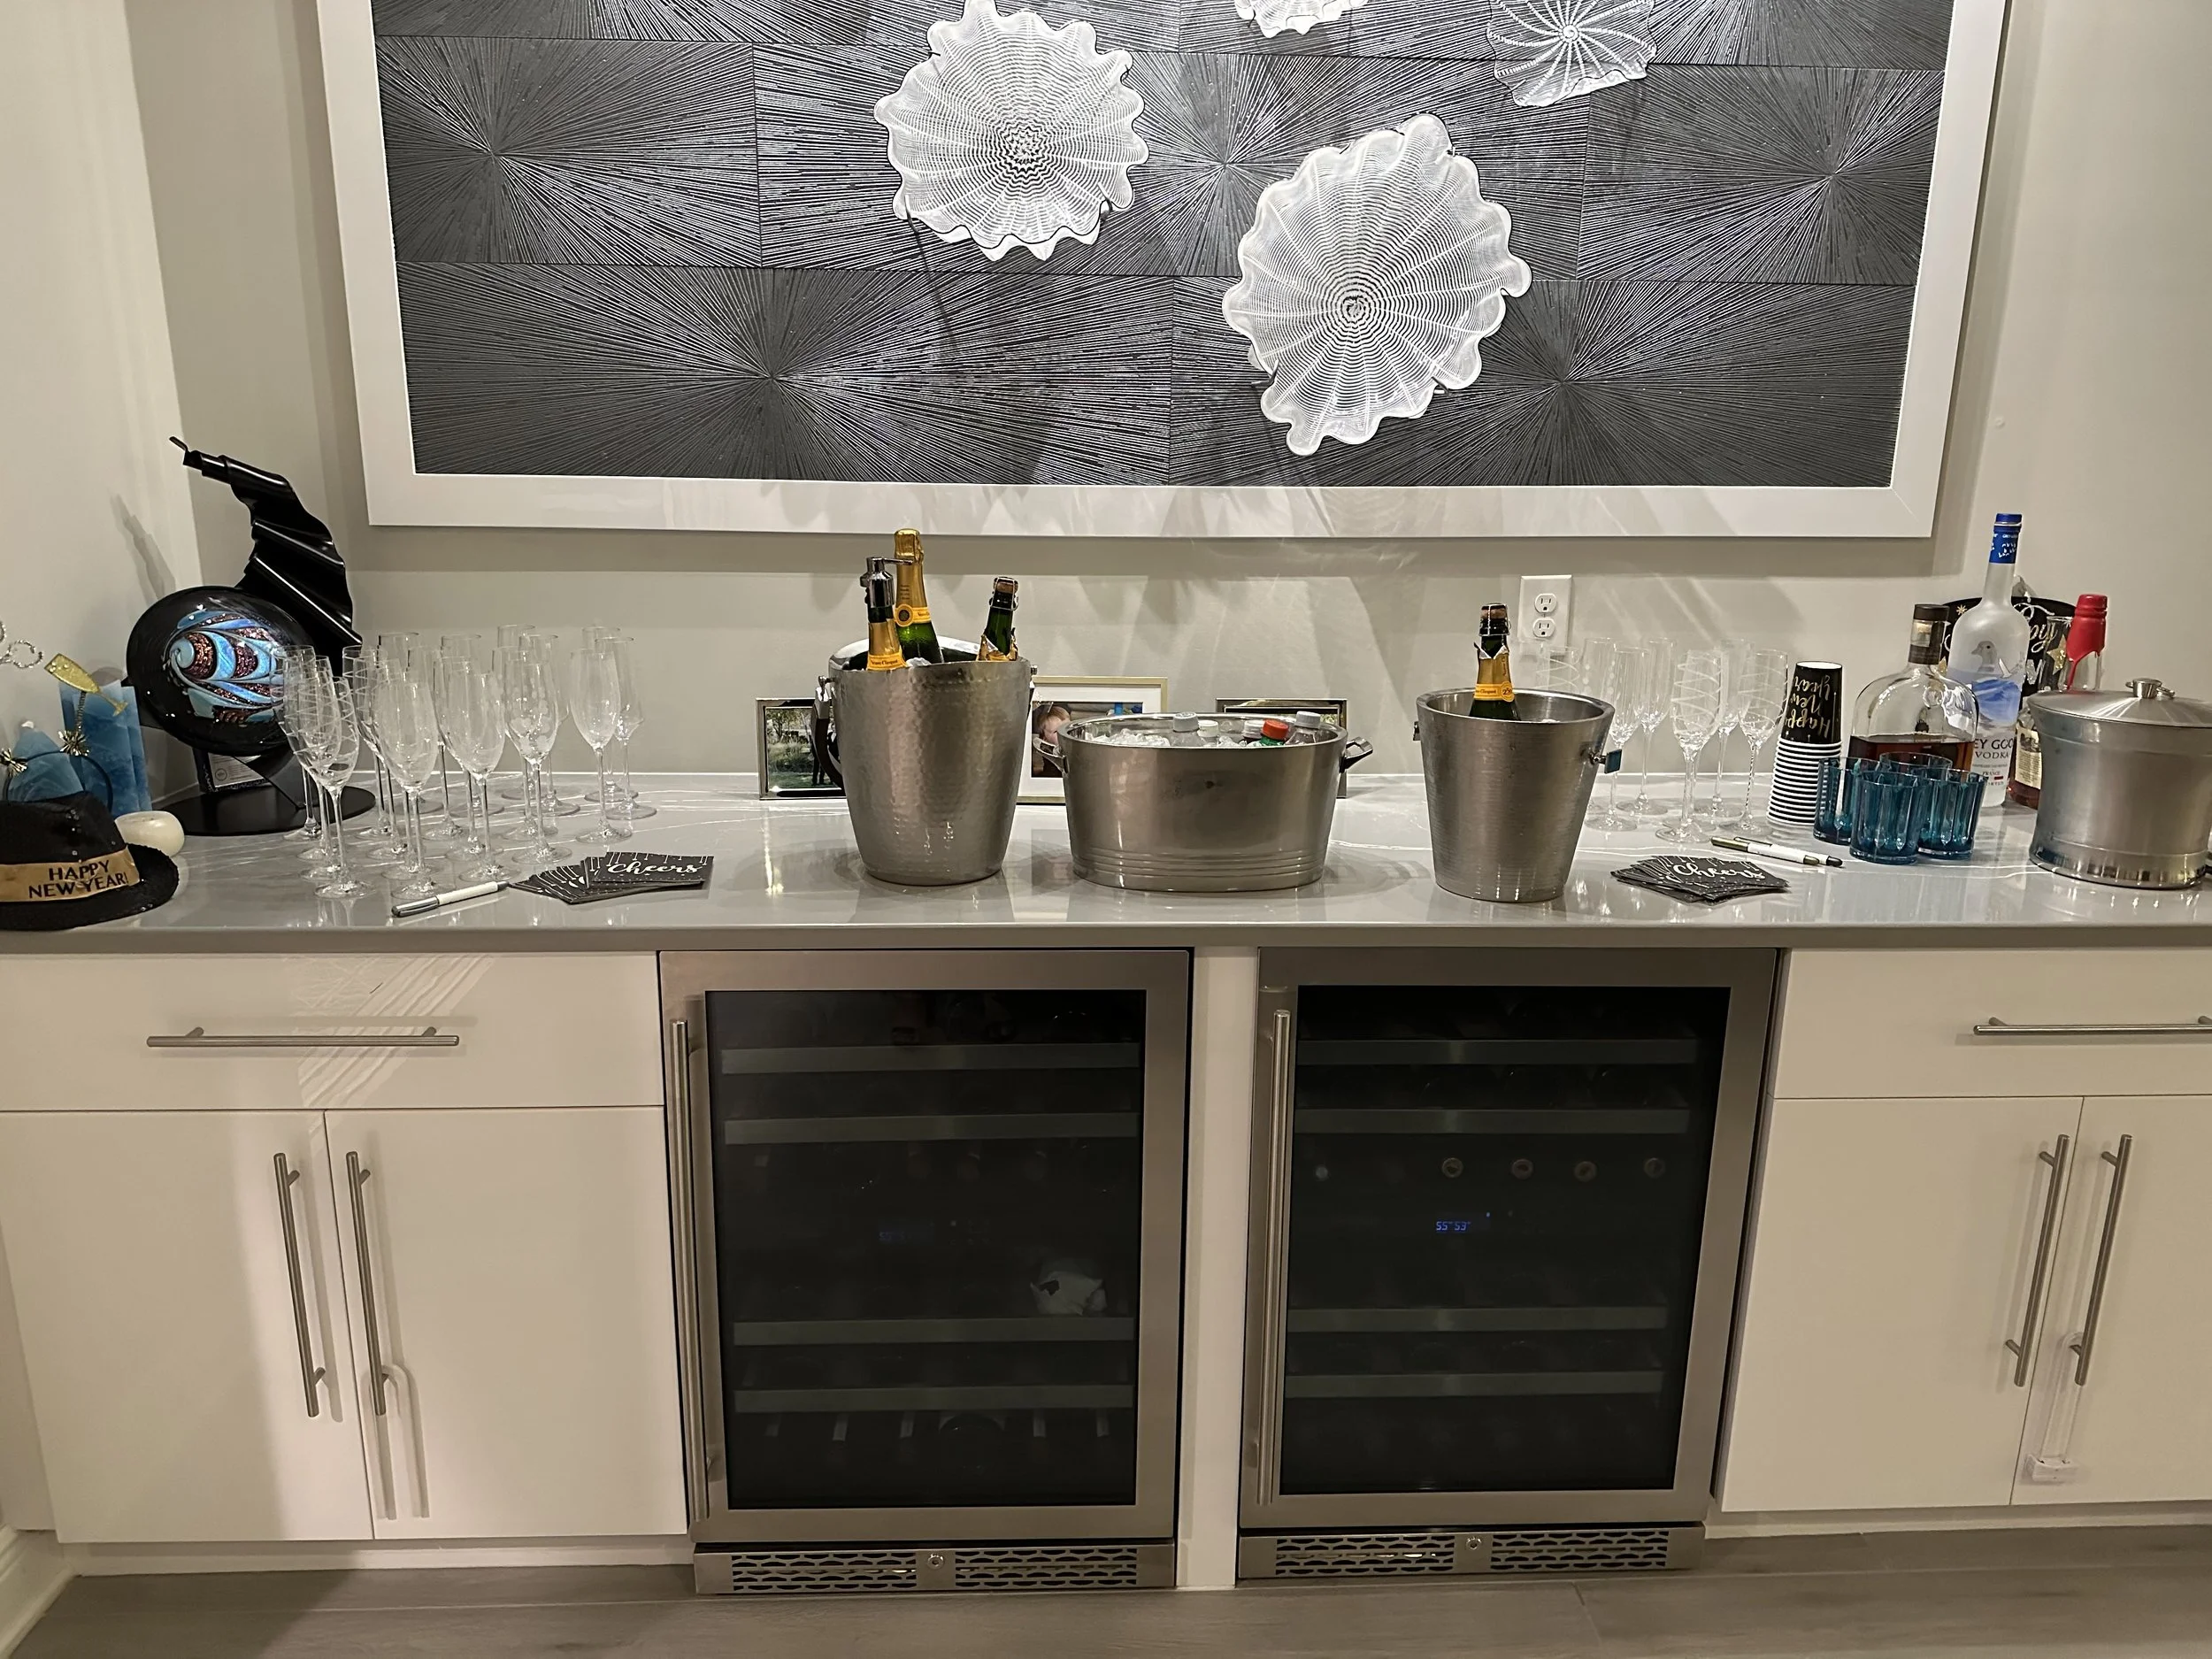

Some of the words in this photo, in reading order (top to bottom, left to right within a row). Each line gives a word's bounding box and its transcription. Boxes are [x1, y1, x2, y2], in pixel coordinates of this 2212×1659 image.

[1974, 750, 2009, 759] VODKA
[48, 859, 110, 881] HAPPY
[28, 881, 76, 899] NEW
[80, 871, 130, 893] YEAR!
